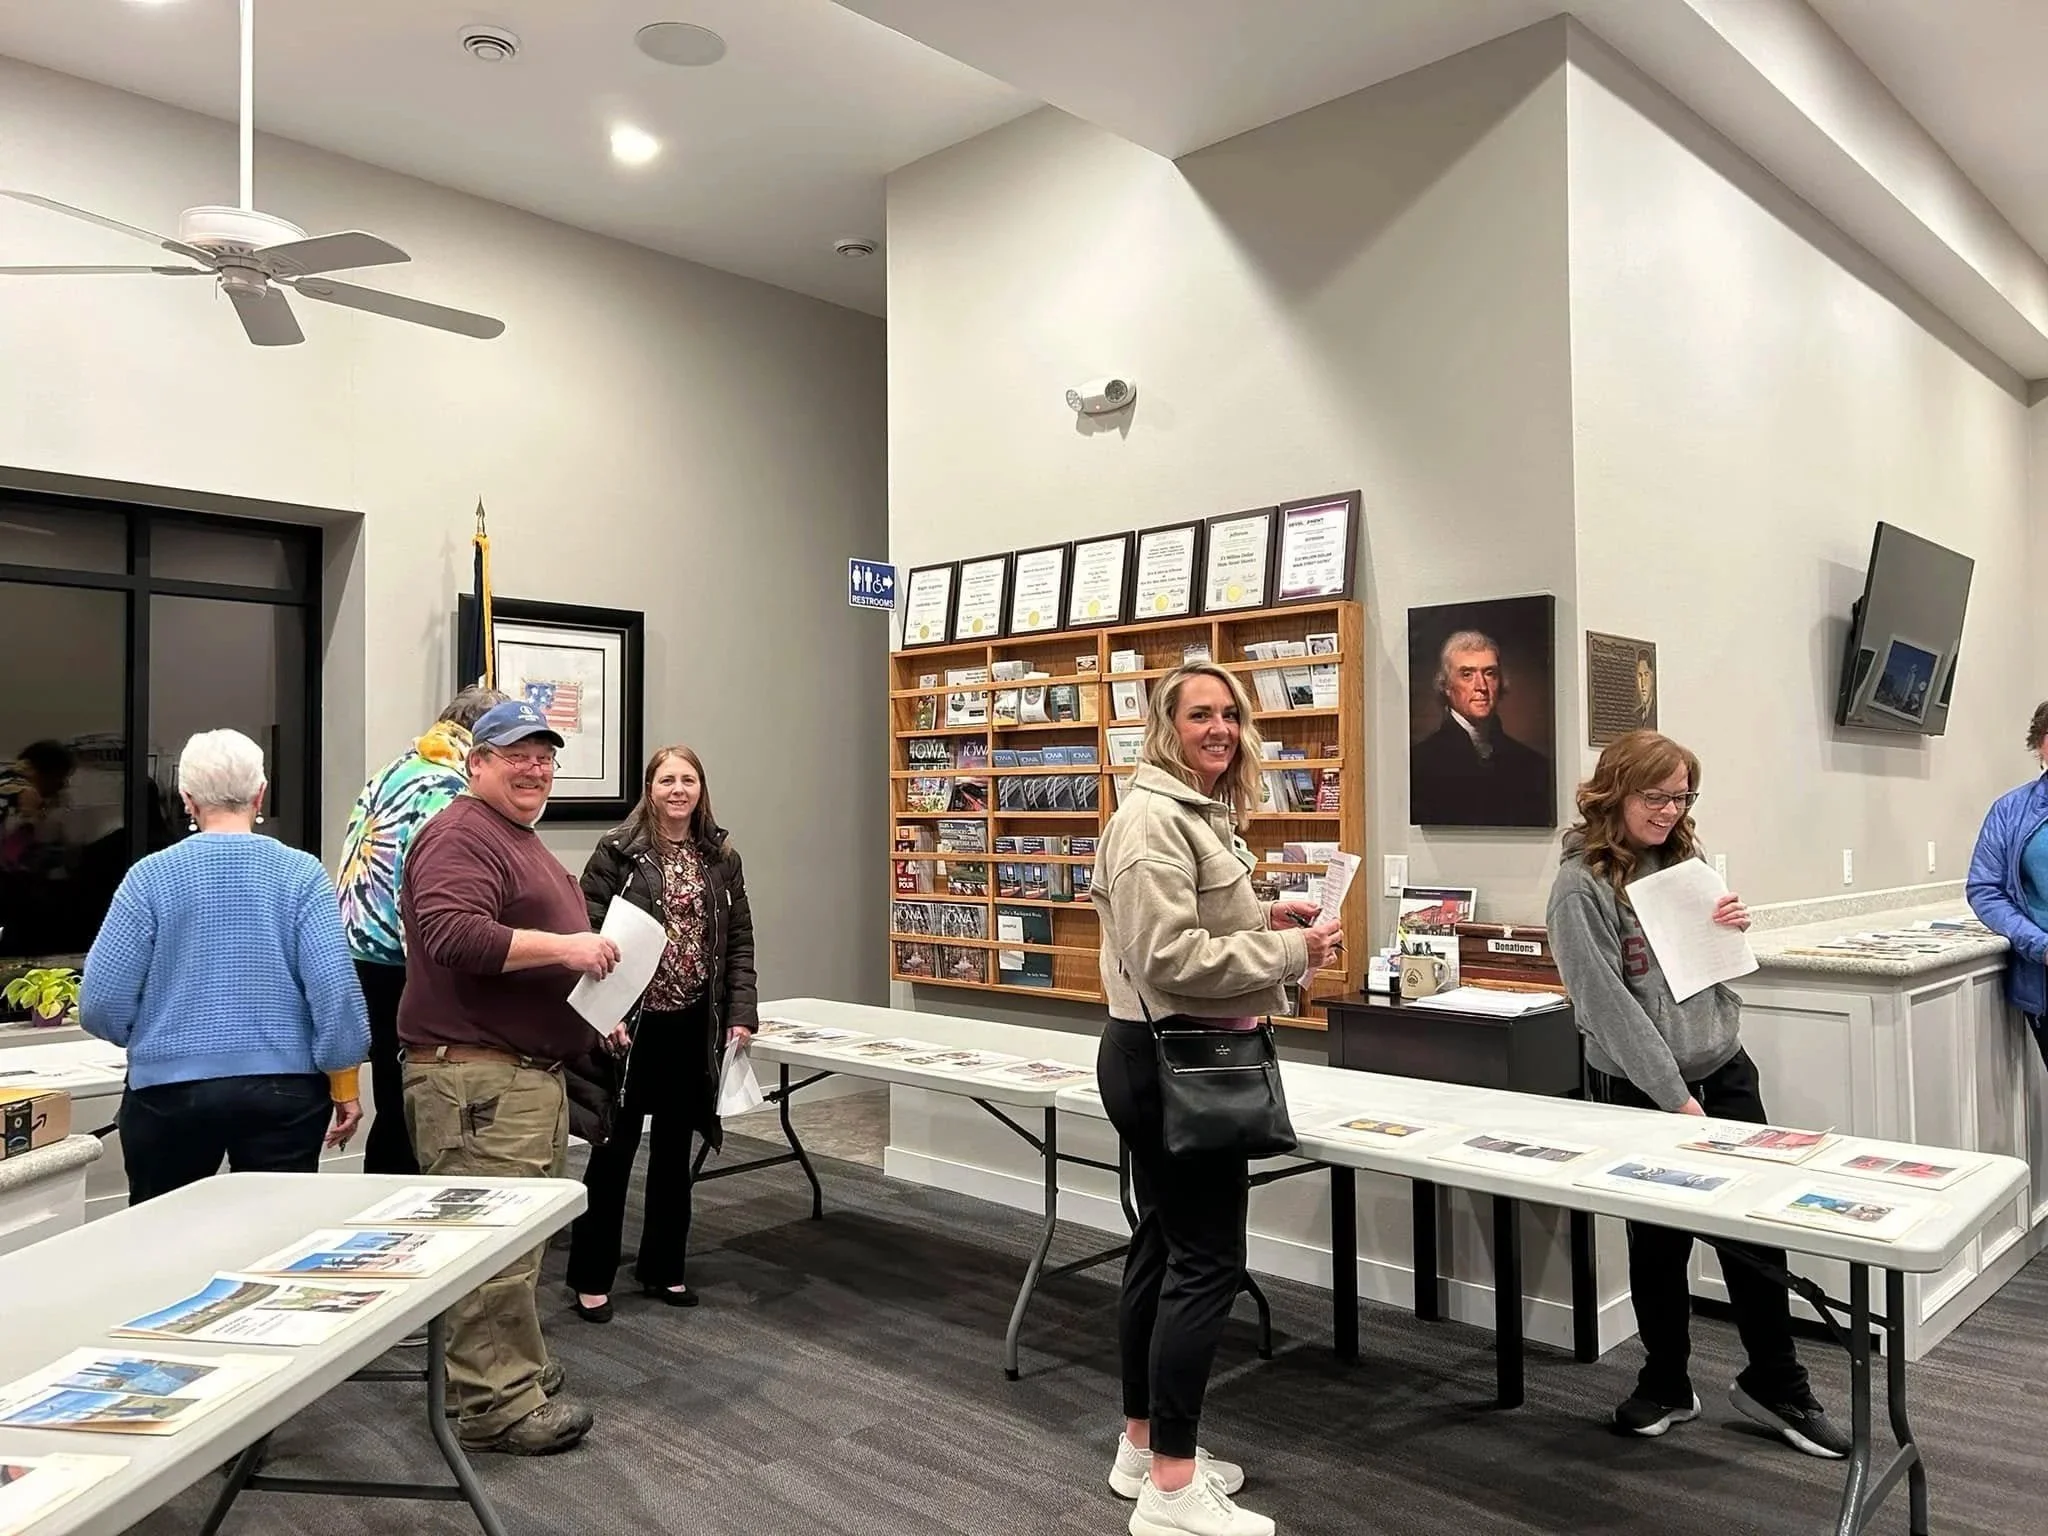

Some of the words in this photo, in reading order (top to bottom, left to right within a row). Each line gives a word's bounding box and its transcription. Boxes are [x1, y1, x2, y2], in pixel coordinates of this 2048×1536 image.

[852, 595, 894, 608] RESTROOMS
[911, 743, 947, 759] IOWA
[1495, 942, 1535, 953] Donations
